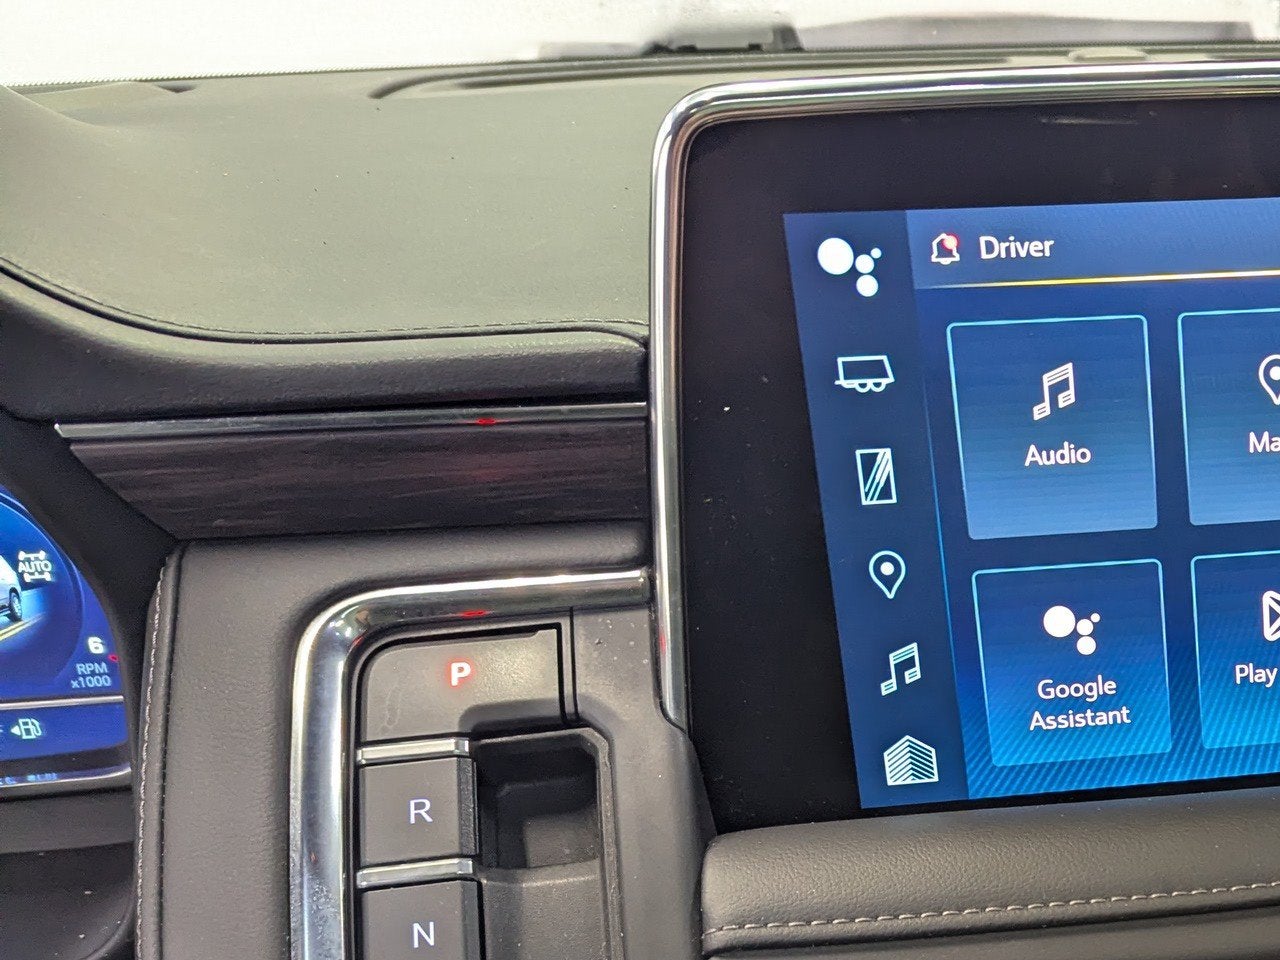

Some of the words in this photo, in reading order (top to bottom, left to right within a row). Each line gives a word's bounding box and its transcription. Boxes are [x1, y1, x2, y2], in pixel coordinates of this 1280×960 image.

[978, 235, 1056, 260] Driver
[1024, 441, 1092, 468] Audio
[18, 560, 52, 573] AUTO
[87, 636, 105, 654] 6
[75, 661, 109, 675] RPM
[450, 661, 472, 686] P
[1234, 662, 1278, 689] Play
[70, 675, 112, 689] x1000
[1037, 675, 1118, 702] Google
[1029, 706, 1132, 731] Assistant
[409, 798, 433, 824] R
[412, 921, 436, 949] N
